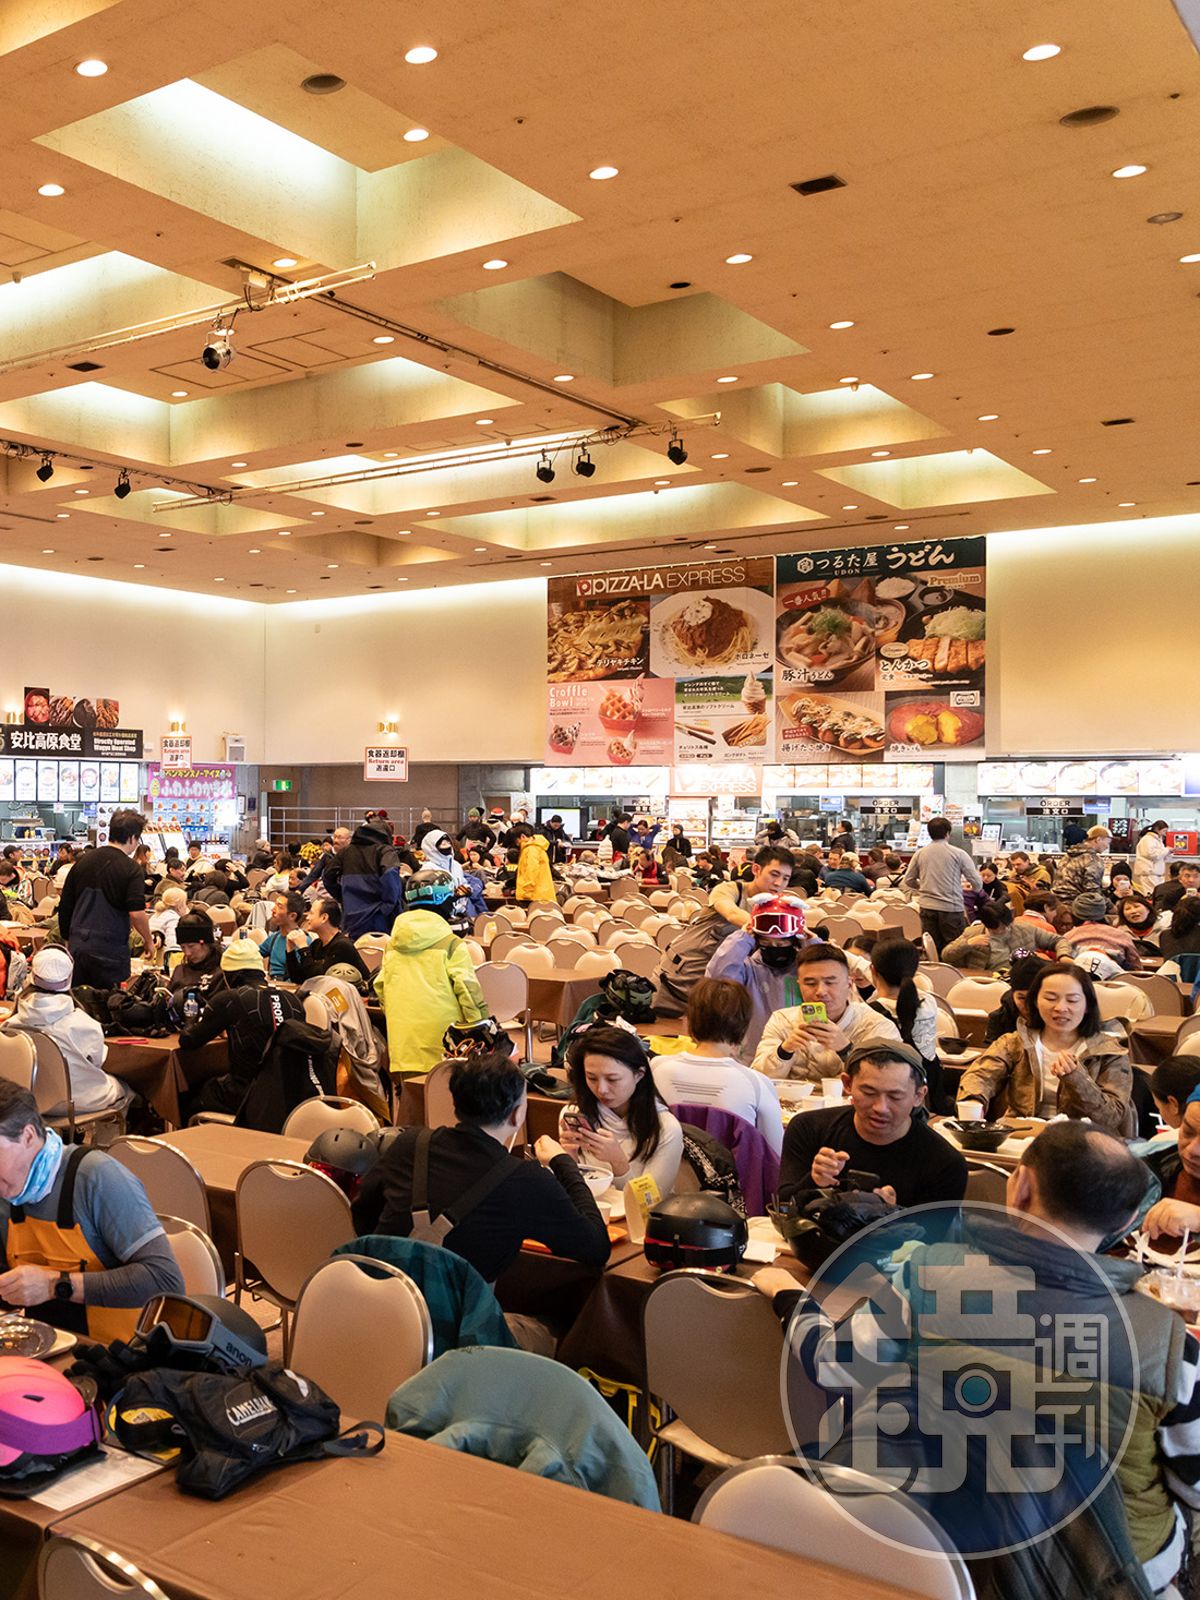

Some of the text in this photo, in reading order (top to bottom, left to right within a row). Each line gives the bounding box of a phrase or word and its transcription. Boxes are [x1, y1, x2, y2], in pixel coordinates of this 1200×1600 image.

[816, 544, 955, 569] つるた屋 うどん
[834, 568, 861, 576] UDON
[592, 567, 746, 596] PIZZA-LA EXPRESS
[928, 572, 982, 587] Premium
[879, 658, 931, 672] とんかつ
[781, 668, 834, 682] 豚汁うどん
[549, 685, 588, 698] Croffle
[549, 697, 574, 708] Bowl
[10, 730, 82, 750] 安比高原食堂
[1040, 799, 1071, 807] ORDER
[226, 1342, 253, 1367] anon
